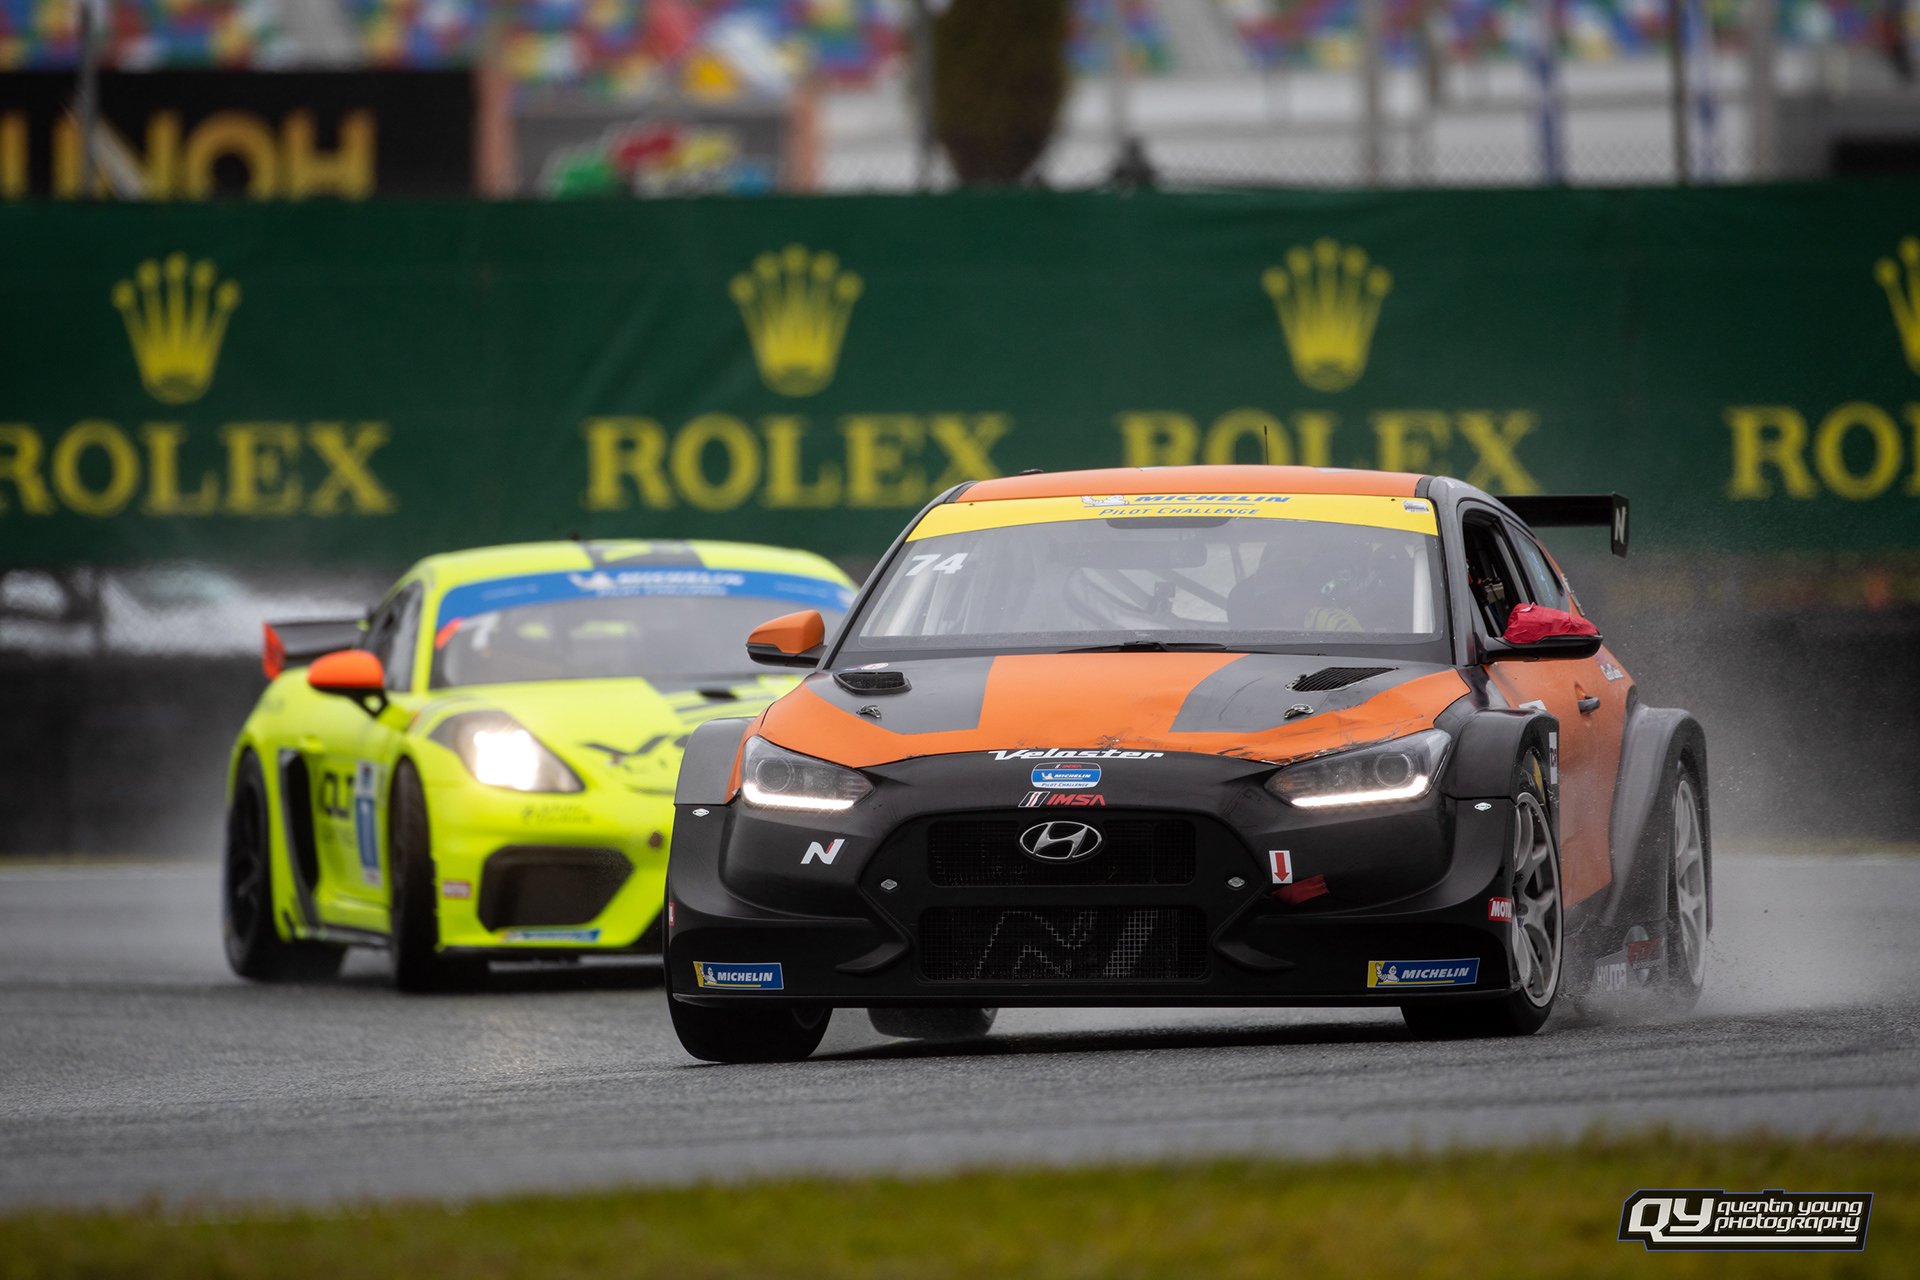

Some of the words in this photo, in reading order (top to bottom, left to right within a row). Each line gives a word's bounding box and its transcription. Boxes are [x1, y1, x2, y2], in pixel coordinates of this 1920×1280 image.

[1726, 402, 1920, 499] RO
[584, 414, 1010, 510] ROLEX
[1134, 495, 1291, 503] MICHELIN
[1099, 508, 1152, 516] PILOT
[1157, 507, 1261, 515] CHALLENGE
[904, 552, 969, 577] 74
[988, 747, 1165, 761] Veloster
[1046, 793, 1106, 807] IMSA
[717, 971, 773, 982] MICHELIN
[1401, 967, 1470, 979] MICHELIN
